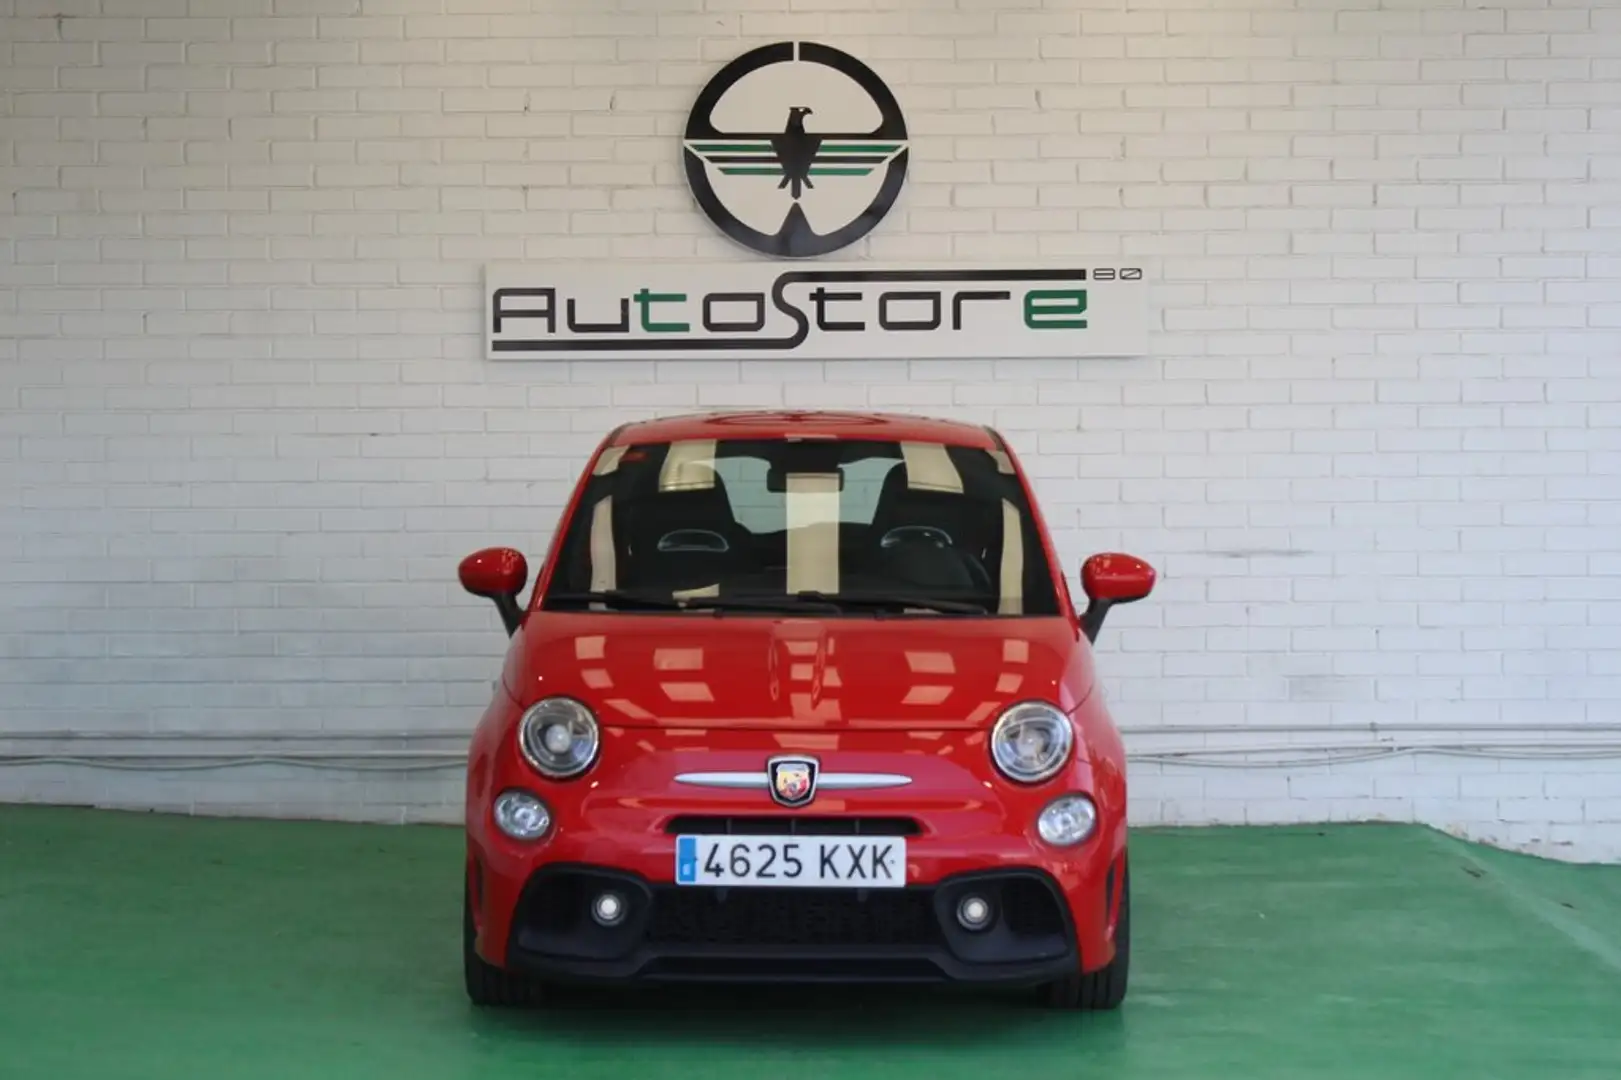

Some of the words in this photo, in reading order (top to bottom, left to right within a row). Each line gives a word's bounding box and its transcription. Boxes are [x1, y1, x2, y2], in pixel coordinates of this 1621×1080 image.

[492, 269, 1087, 351] AutoStore
[704, 843, 803, 878] 4625
[819, 844, 893, 879] KXK
